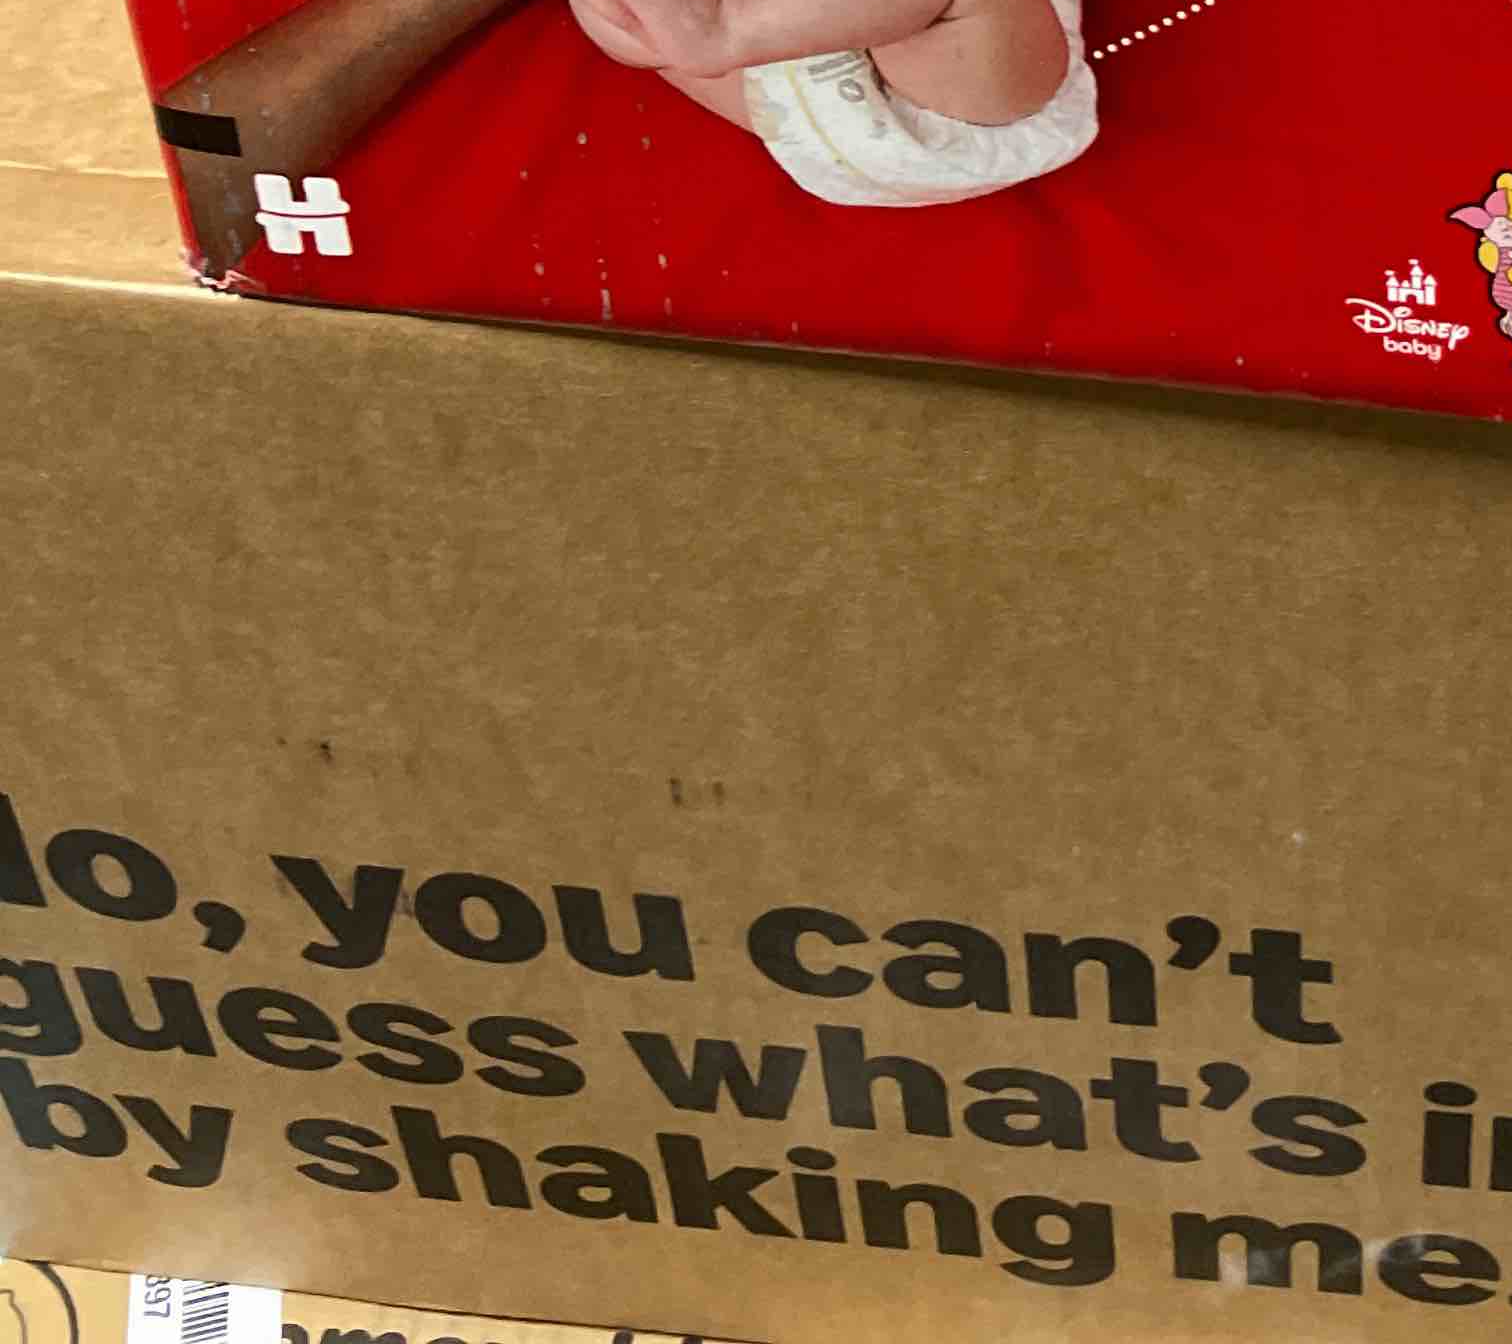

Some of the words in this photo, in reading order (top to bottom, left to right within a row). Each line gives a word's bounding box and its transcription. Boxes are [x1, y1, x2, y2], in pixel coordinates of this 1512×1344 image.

[1382, 335, 1442, 362] baby
[267, 853, 698, 985] you
[745, 904, 1344, 1047] can't
[0, 957, 589, 1099] guess
[620, 1023, 1369, 1178] what's
[0, 1056, 235, 1188] by
[281, 1103, 1117, 1289] shaking
